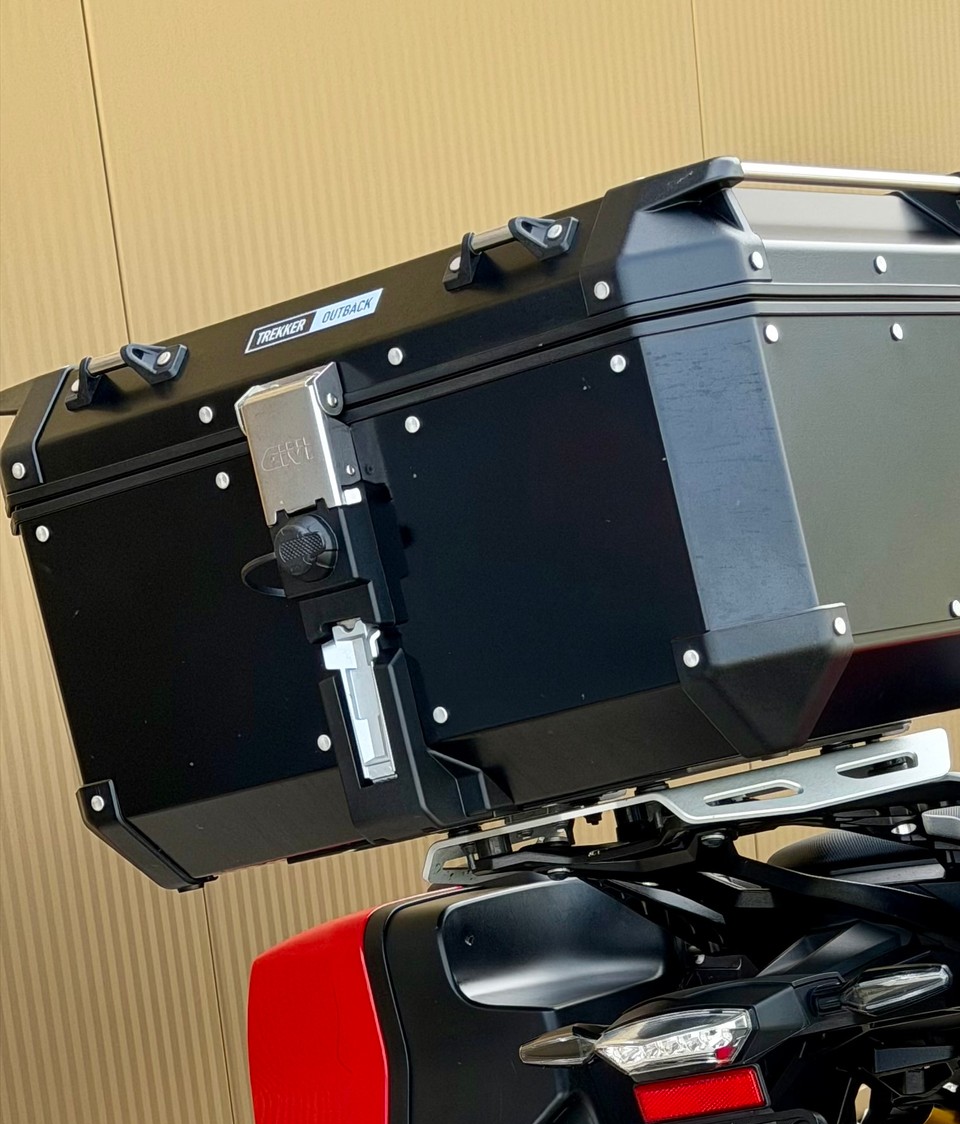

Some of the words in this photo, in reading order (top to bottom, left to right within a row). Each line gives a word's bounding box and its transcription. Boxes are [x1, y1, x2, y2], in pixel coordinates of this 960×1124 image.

[256, 318, 307, 346] TREKKER
[321, 297, 374, 324] OUTBACK
[261, 436, 313, 472] GIVI
